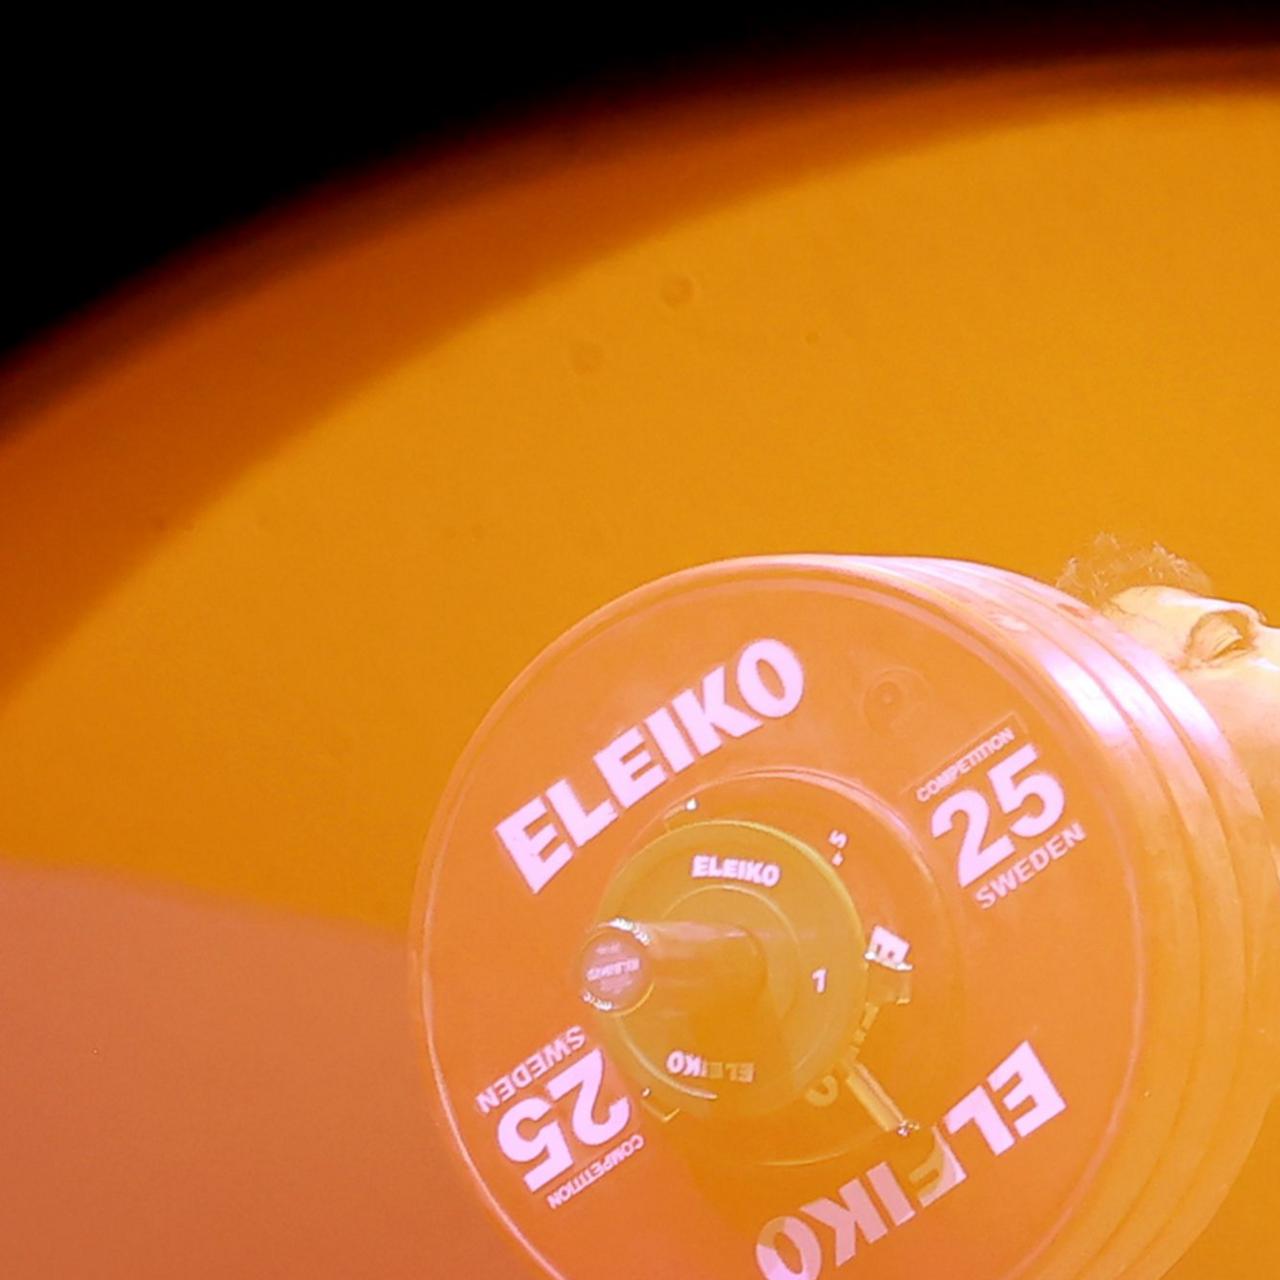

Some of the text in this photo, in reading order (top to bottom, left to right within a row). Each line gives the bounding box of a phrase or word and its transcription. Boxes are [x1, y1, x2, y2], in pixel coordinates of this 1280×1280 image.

[495, 638, 805, 894] ELEIKO
[916, 727, 1015, 802] COMPETITION
[931, 743, 1065, 888] 25
[691, 854, 780, 887] ELEIKO
[975, 821, 1086, 909] SWEDEN
[811, 967, 827, 993] 1
[475, 1025, 586, 1114] SWEDEN
[666, 1050, 754, 1083] ELEIKO
[498, 1047, 630, 1193] 25
[547, 1134, 645, 1209] COMPETITION
